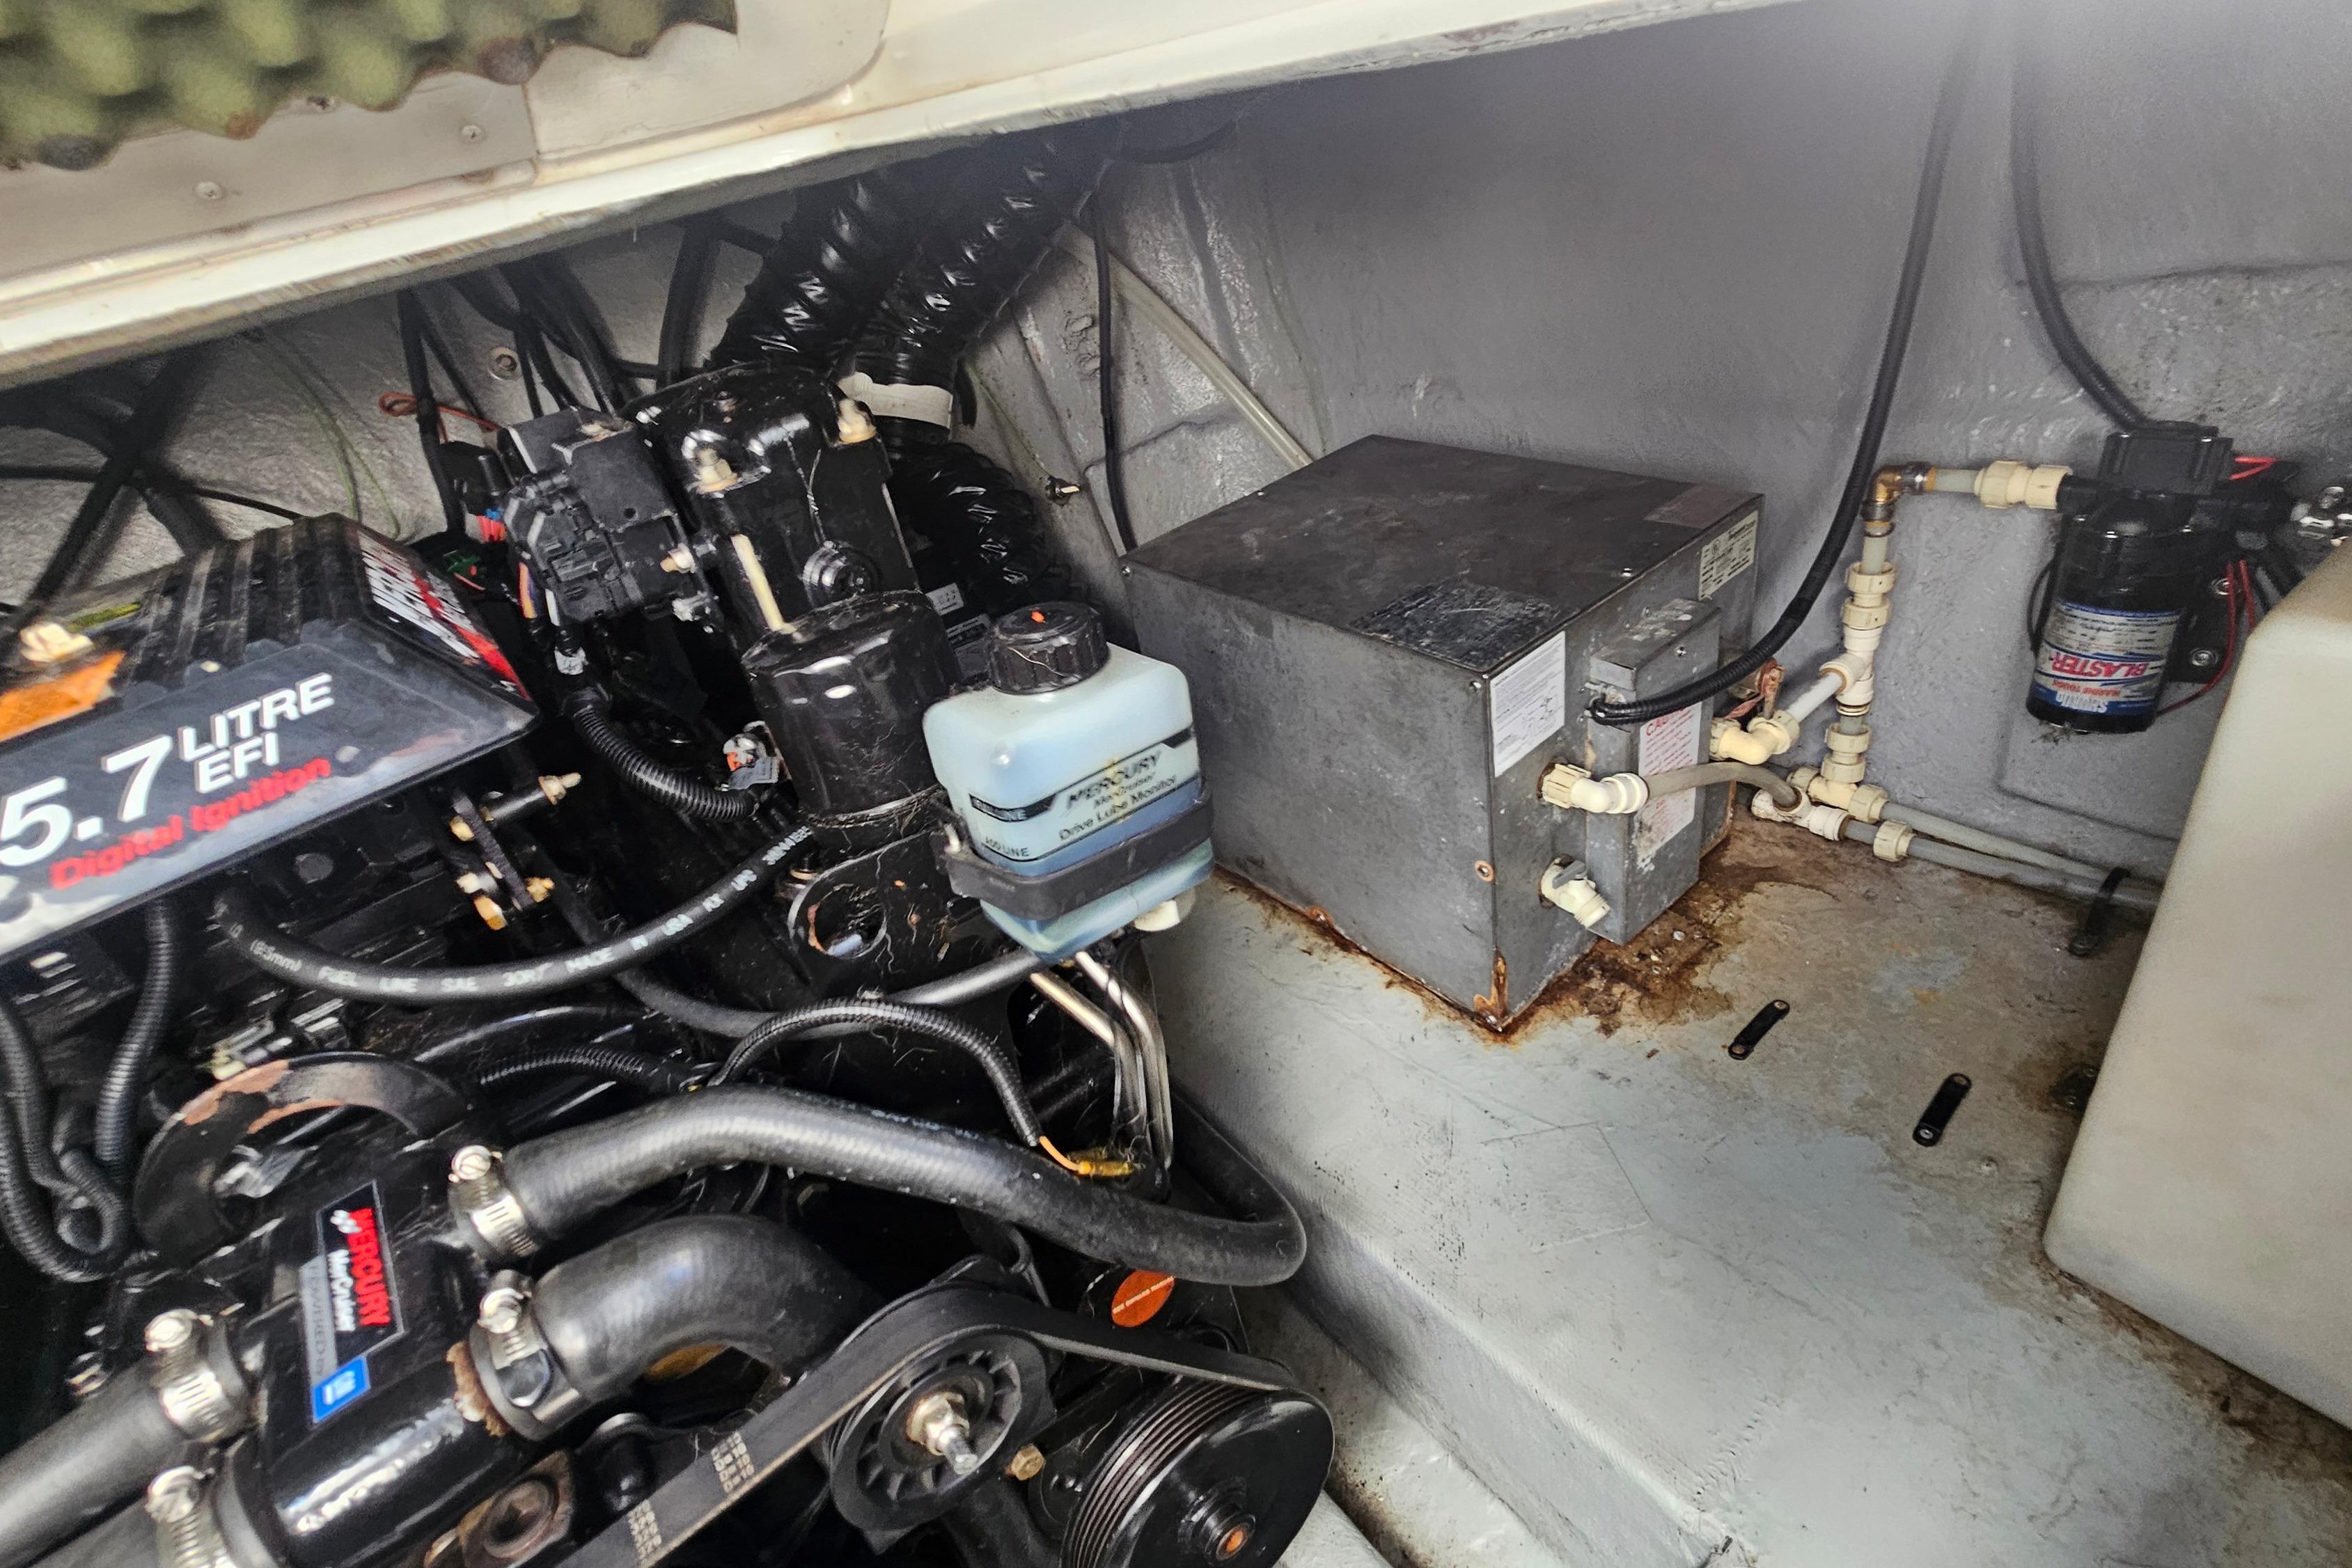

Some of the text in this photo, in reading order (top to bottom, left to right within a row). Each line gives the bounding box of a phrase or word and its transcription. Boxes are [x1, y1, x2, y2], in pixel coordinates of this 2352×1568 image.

[2053, 653, 2150, 677] BLASTER
[0, 673, 334, 868] 5.7 LITRE
[194, 731, 279, 794] EFI
[1066, 750, 1161, 808] MERCURY
[49, 757, 332, 890] Digital Ignition
[1059, 774, 1177, 841] Drive Lube Monitor
[347, 1207, 391, 1326] MERCURY
